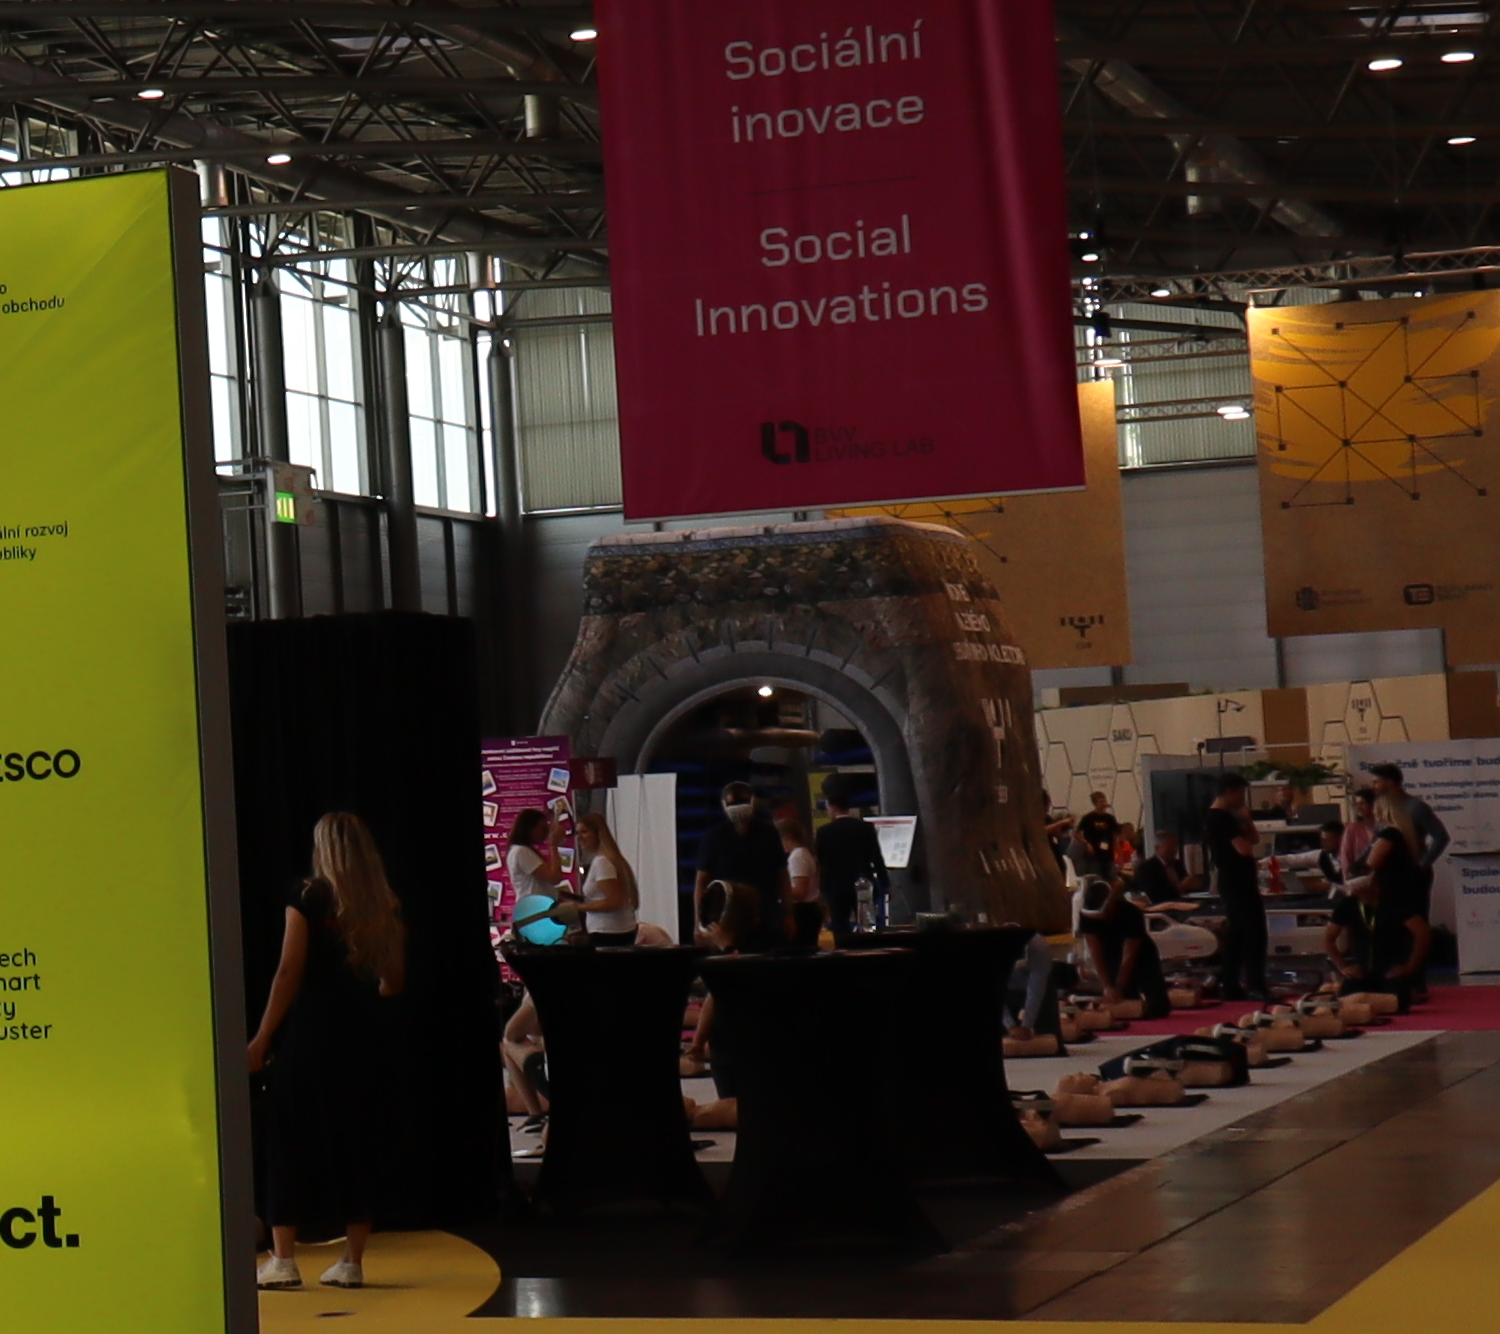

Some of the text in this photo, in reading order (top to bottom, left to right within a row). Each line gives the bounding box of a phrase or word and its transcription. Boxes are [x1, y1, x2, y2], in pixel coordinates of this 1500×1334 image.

[725, 19, 922, 81] Sociální
[732, 94, 924, 144] inovace
[760, 214, 911, 267] Social
[1, 295, 64, 314] obchodu
[695, 277, 988, 338] Innovations
[816, 438, 934, 462] LIVING LAB
[25, 520, 68, 537] rozvoj
